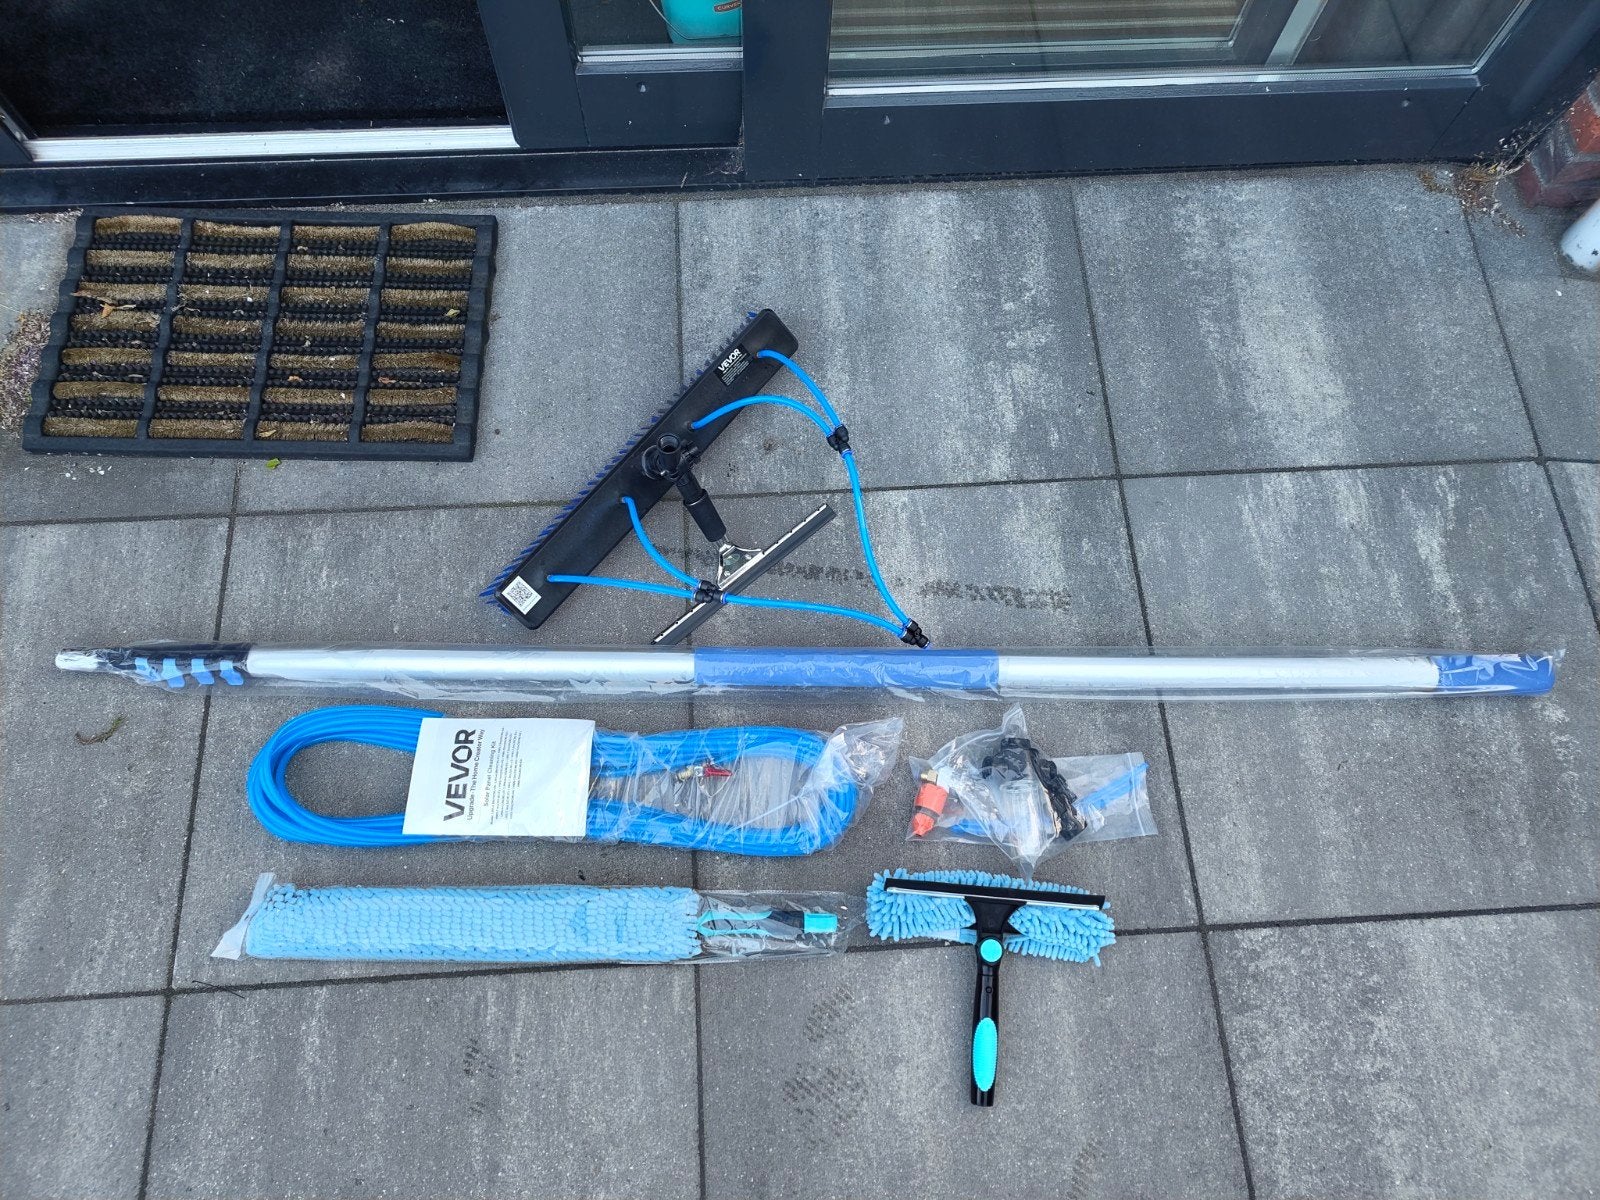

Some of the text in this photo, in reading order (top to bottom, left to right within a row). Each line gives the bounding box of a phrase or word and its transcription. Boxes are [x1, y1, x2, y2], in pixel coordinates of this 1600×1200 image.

[717, 348, 741, 371] VEVOR
[472, 762, 480, 780] Home
[488, 750, 496, 774] Cleaning
[443, 729, 476, 821] VEVOR
